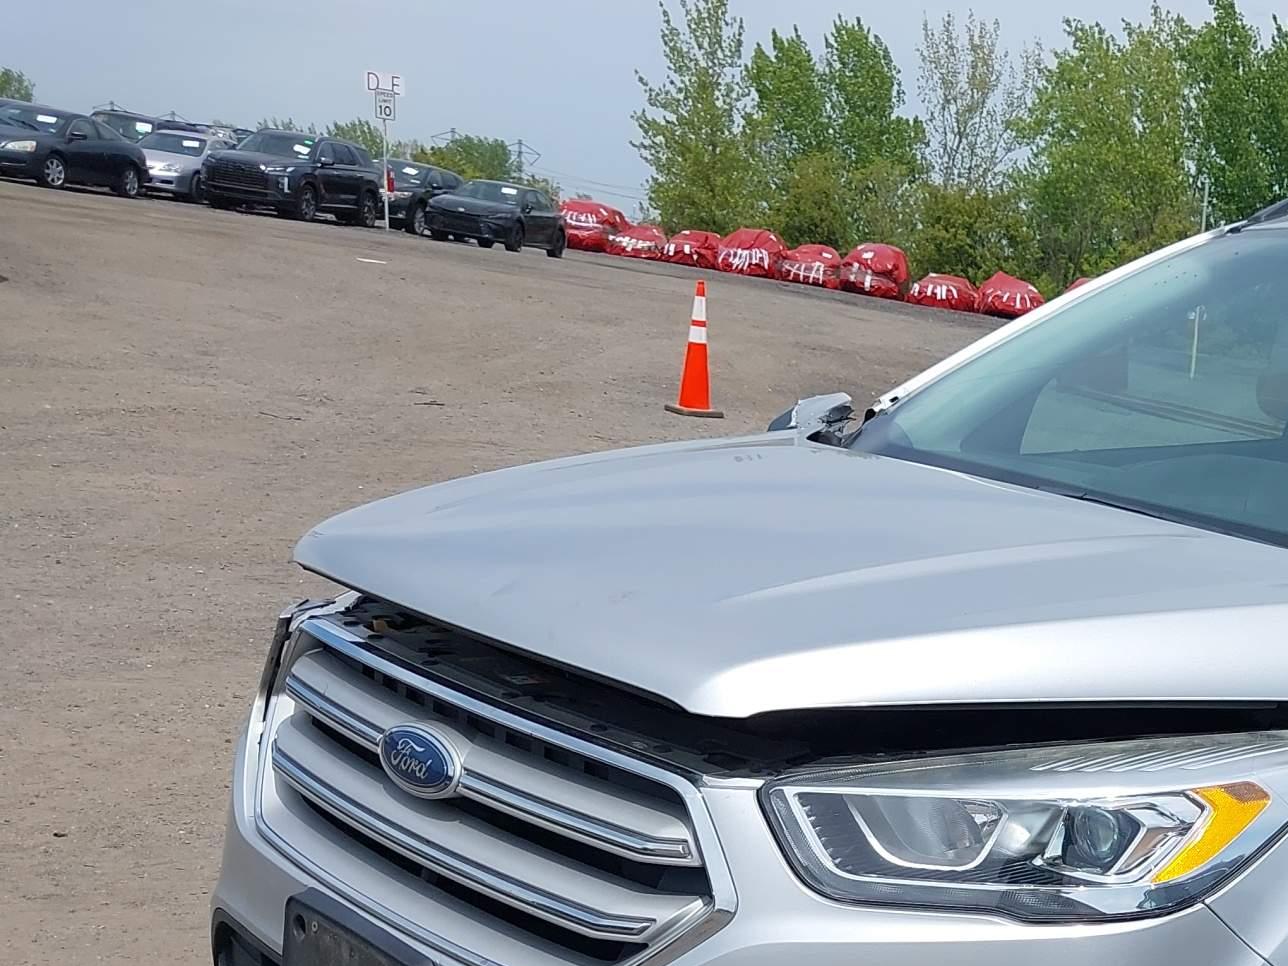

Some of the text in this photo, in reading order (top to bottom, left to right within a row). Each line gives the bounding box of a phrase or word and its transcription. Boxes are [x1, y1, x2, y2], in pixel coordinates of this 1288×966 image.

[367, 72, 401, 96] D E
[378, 104, 392, 117] 10
[390, 737, 433, 780] Ford
